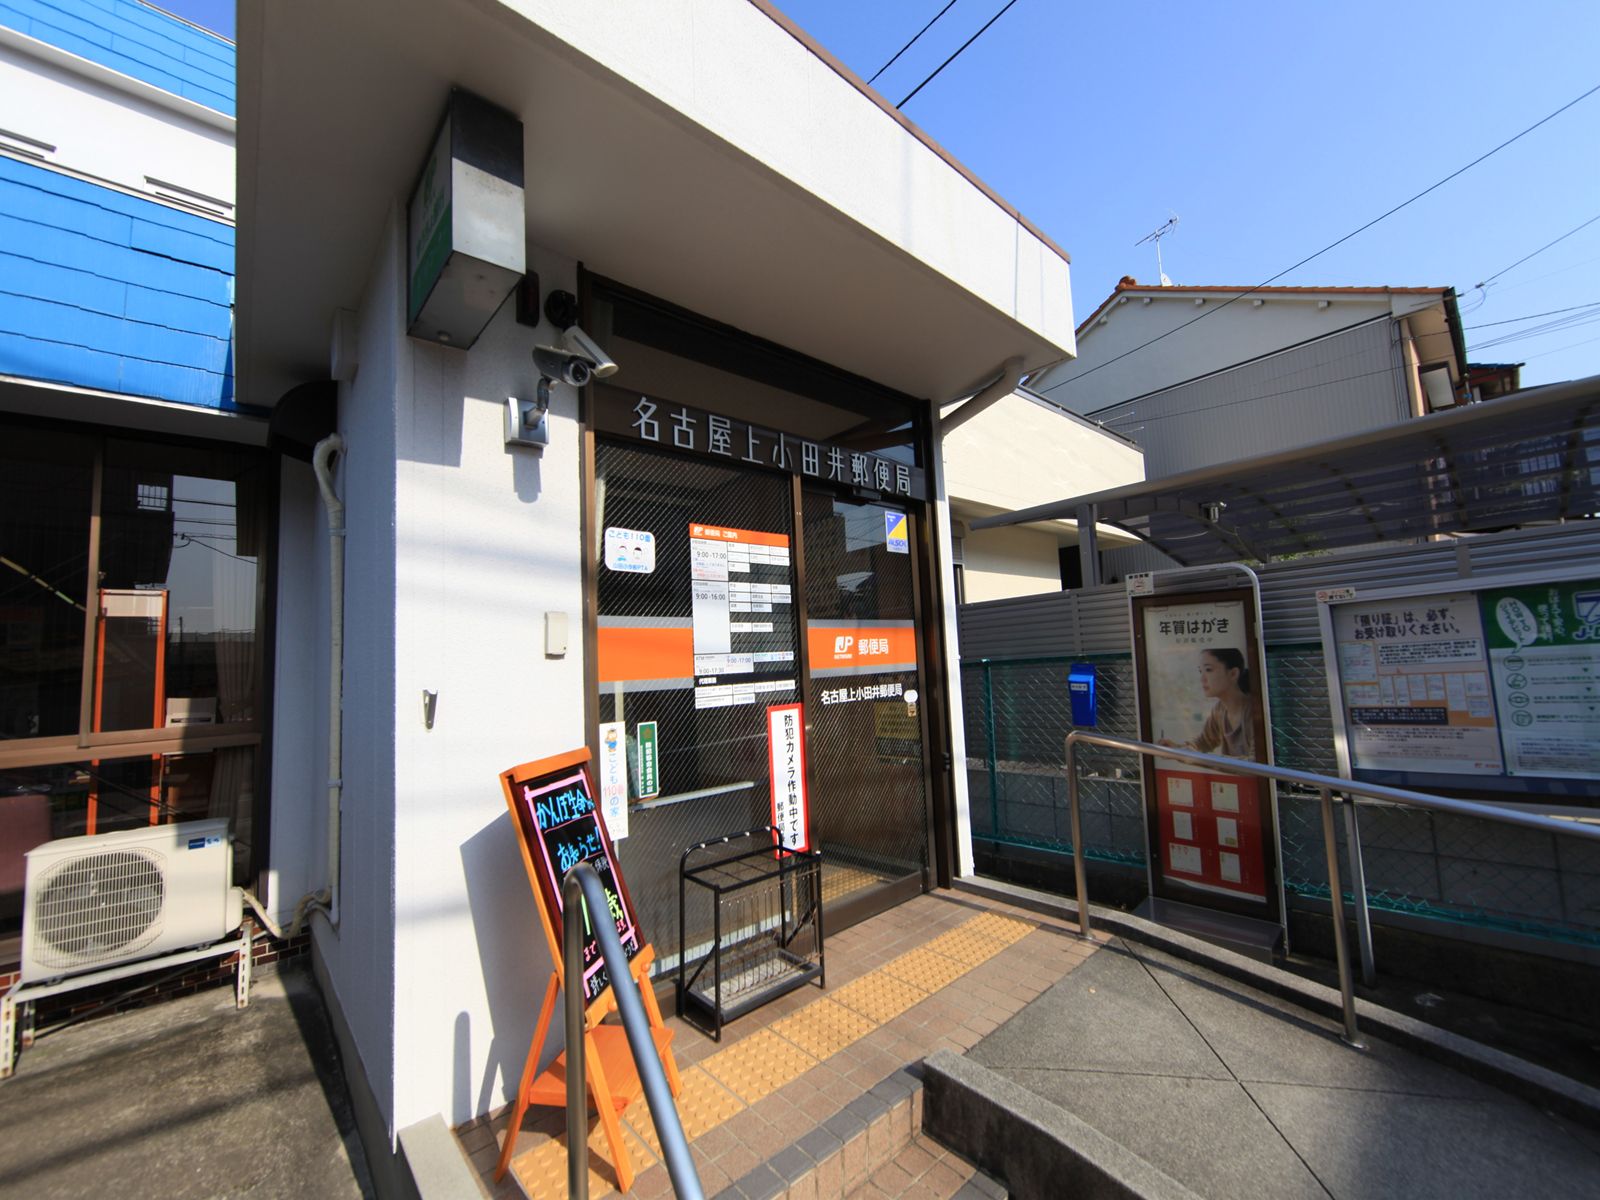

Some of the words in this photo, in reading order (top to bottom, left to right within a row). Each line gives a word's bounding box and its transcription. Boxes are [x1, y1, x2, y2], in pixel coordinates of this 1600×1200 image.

[632, 397, 911, 496] 名古屋上小田井郵便局
[1159, 617, 1230, 636] 年賀はがき
[1354, 622, 1460, 639] お受け取りください。
[858, 638, 889, 655] 郵便局
[821, 683, 903, 705] 名古屋上小田井郵便局
[784, 714, 798, 845] 防犯カメラ作動中です
